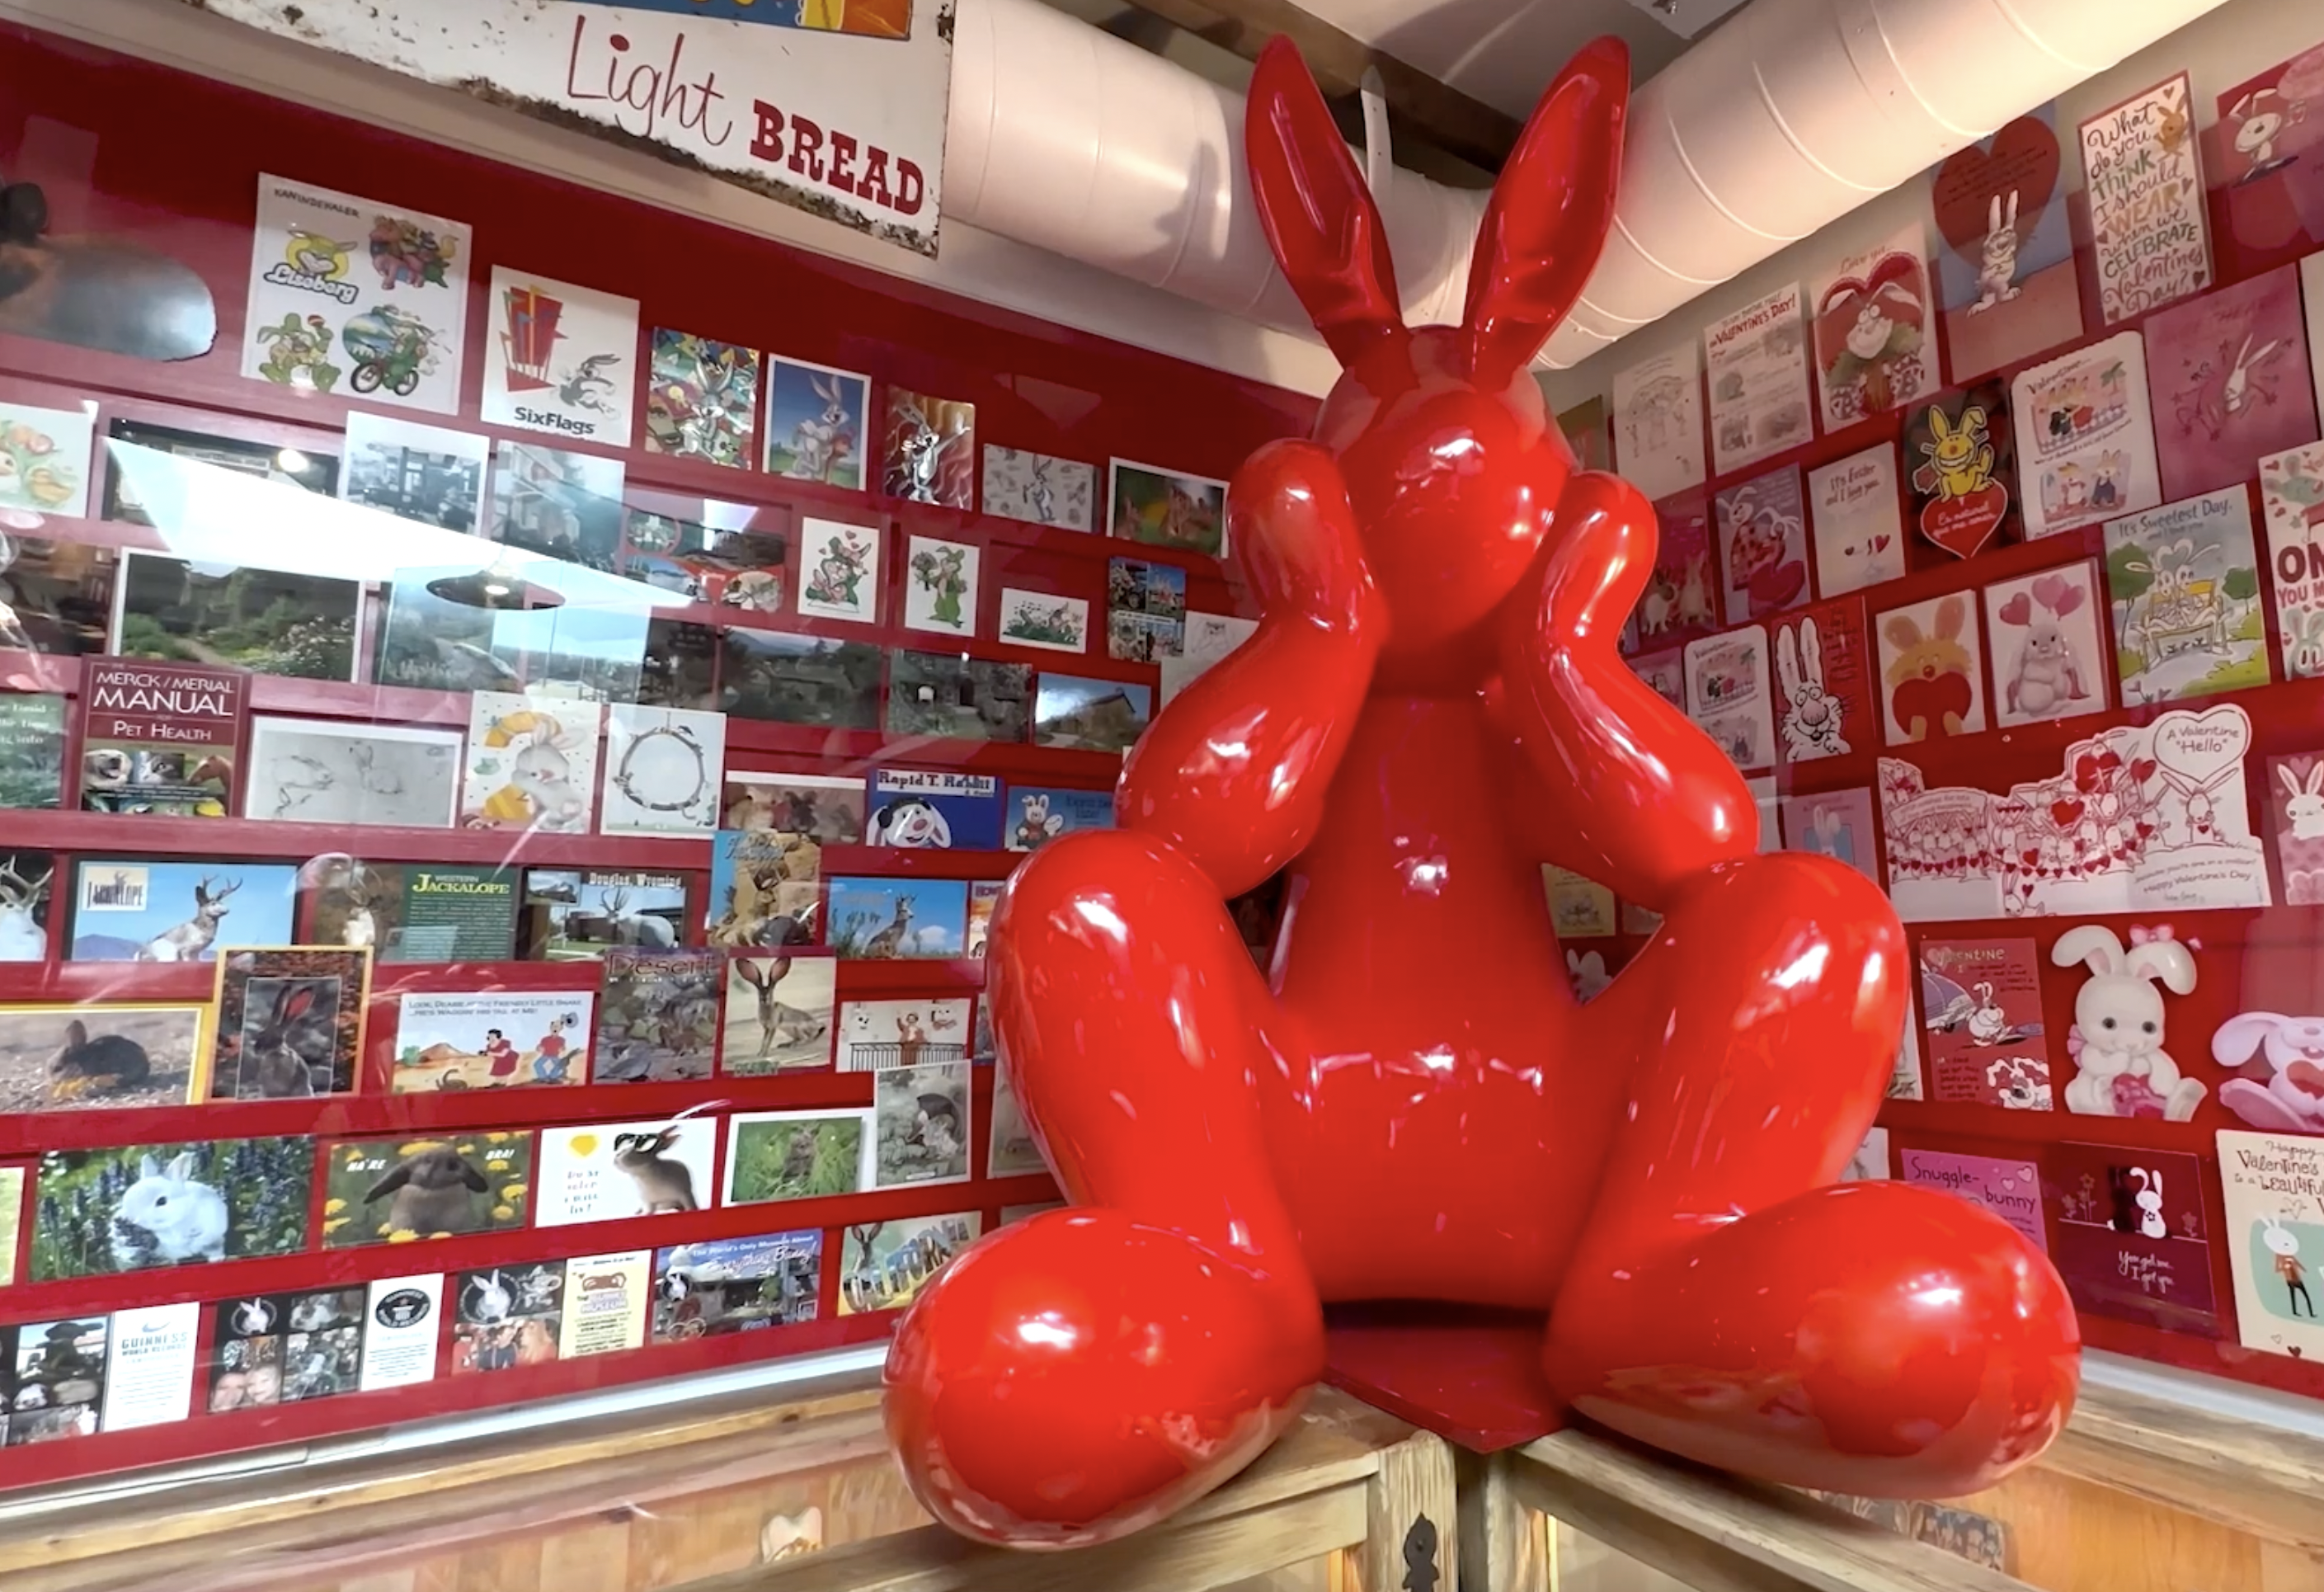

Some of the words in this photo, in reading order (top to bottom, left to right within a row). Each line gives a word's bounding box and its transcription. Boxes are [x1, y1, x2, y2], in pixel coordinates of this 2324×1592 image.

[567, 15, 732, 146] Light
[750, 100, 923, 216] BREAD
[2087, 101, 2157, 148] What
[2091, 151, 2110, 179] do
[2112, 130, 2151, 167] you
[2113, 156, 2184, 212] should
[2105, 182, 2182, 236] WEAR
[2101, 224, 2154, 257] when
[2157, 208, 2188, 228] we
[2105, 223, 2198, 278] CELEBRATE
[2126, 269, 2189, 312] Day?
[1771, 292, 1795, 318] DAY!
[514, 407, 595, 435] SixFlags
[2119, 523, 2137, 537] It's
[2139, 505, 2198, 532] Sweetest
[2201, 498, 2232, 517] Day.
[2277, 585, 2308, 609] YOU
[96, 672, 161, 688] MERCK
[172, 678, 235, 694] MERIAL
[93, 687, 234, 717] MANUAL
[151, 723, 212, 741] HEALTH
[2166, 729, 2176, 741] A
[2179, 726, 2239, 738] Valentine
[2176, 737, 2228, 754] "Hello"
[878, 770, 924, 789] Rapid
[927, 774, 939, 787] T.
[412, 873, 510, 894] JACKALOPE
[2229, 870, 2251, 881] Day
[609, 953, 713, 975] Desert
[2237, 1149, 2319, 1175] Valentine's
[2265, 1140, 2317, 1161] Happy
[1911, 1156, 1980, 1189] Snuggle-
[1984, 1185, 2036, 1214] bunny
[774, 1241, 817, 1265] Bunny!
